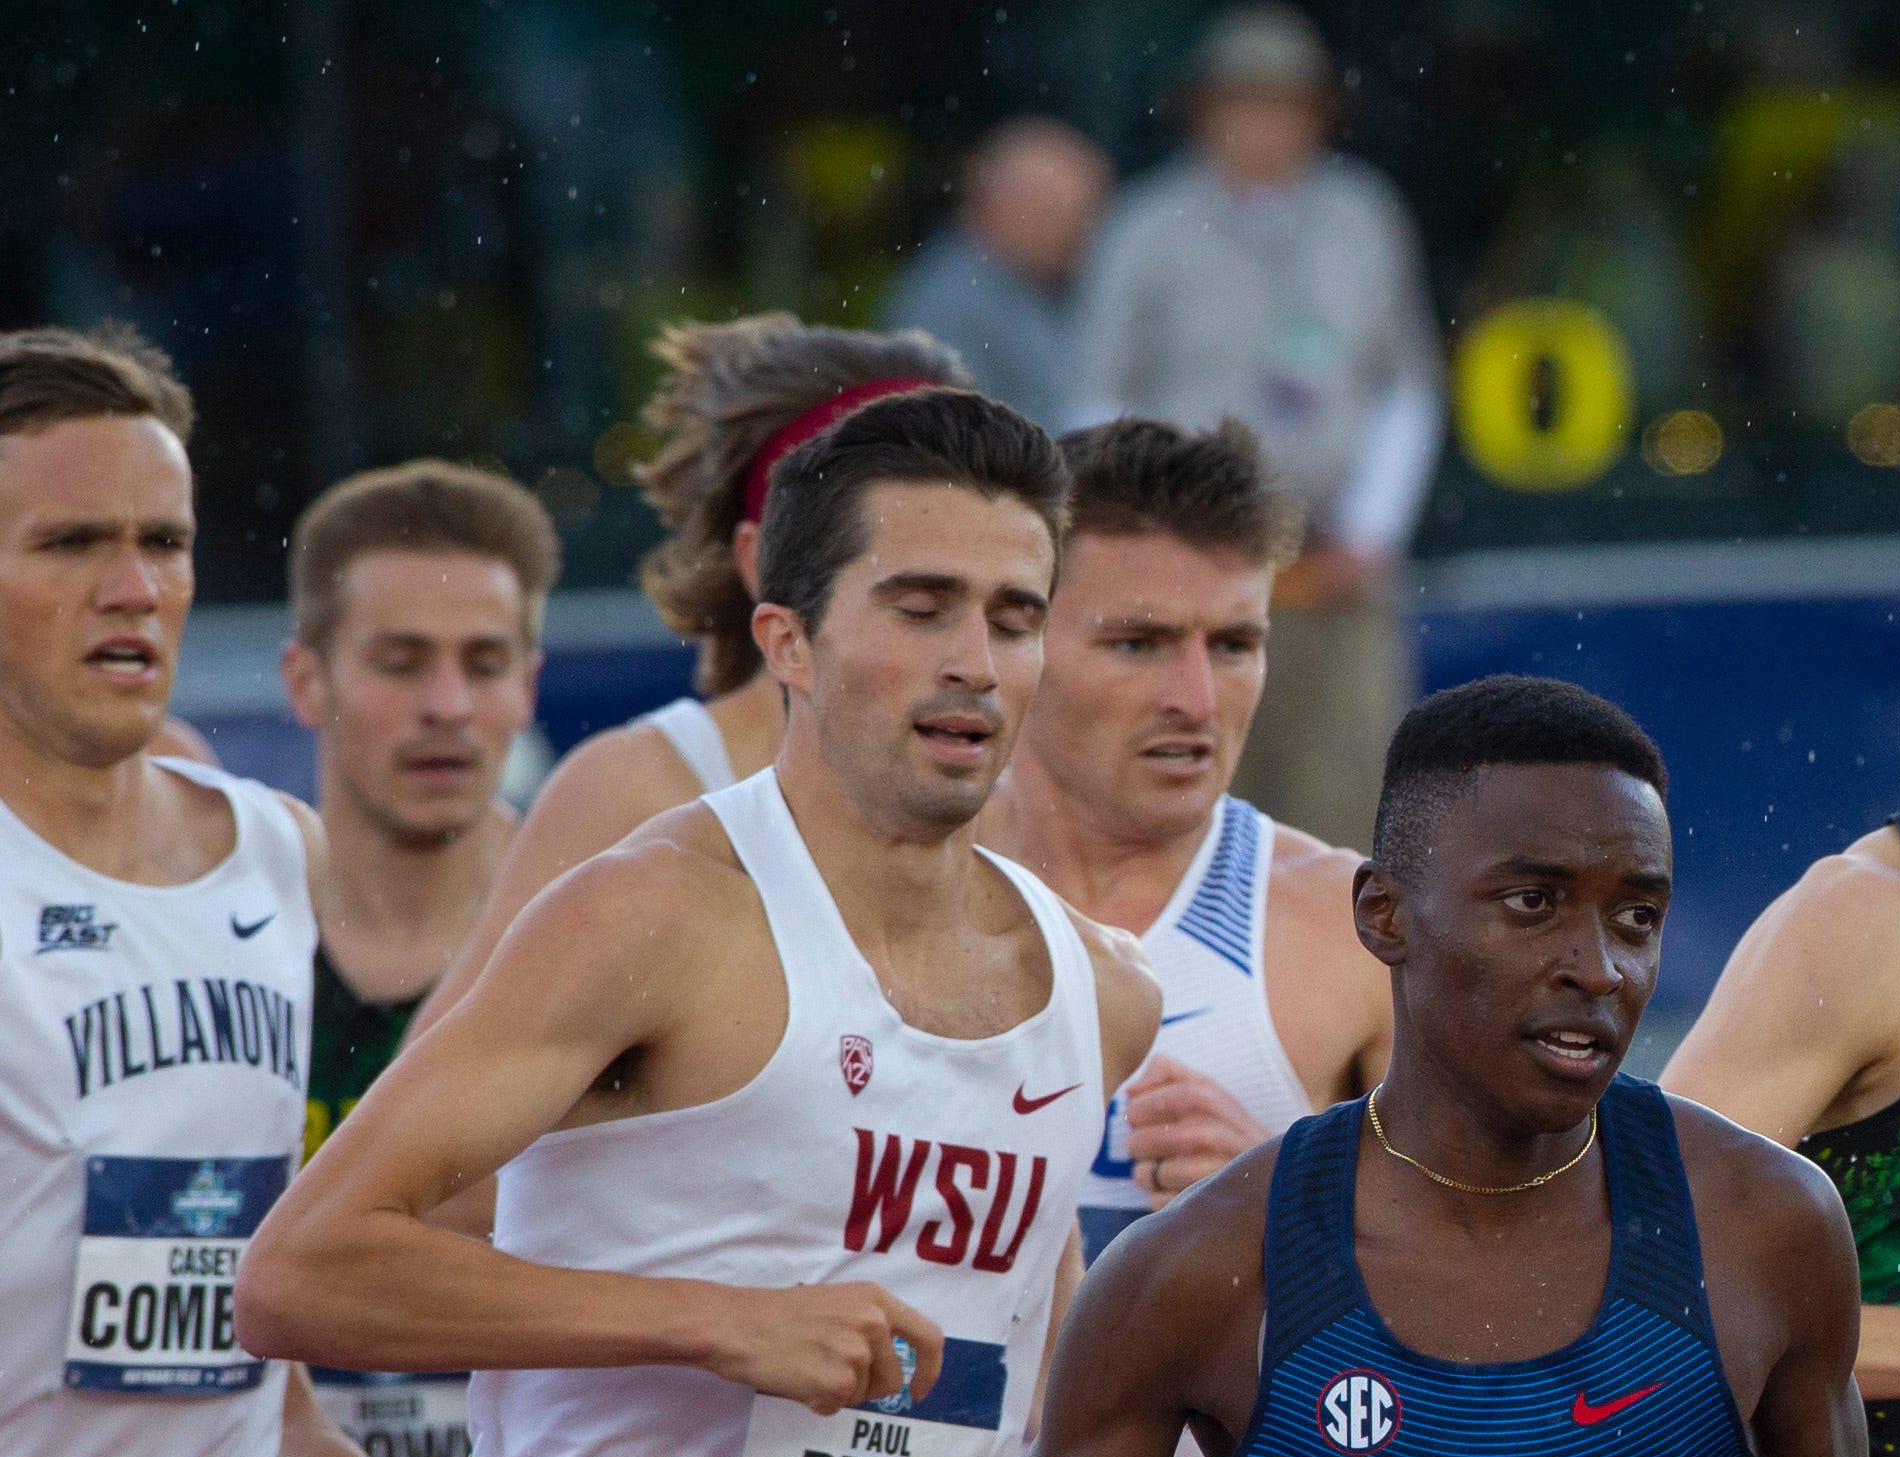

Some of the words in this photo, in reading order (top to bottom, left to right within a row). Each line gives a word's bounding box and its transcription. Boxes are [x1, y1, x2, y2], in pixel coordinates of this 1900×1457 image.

[65, 976, 303, 1100] VILLANOVA
[847, 1062, 867, 1086] 12
[843, 1126, 1048, 1274] WSU
[851, 1418, 912, 1457] PAUL
[1323, 1375, 1395, 1450] SEC
